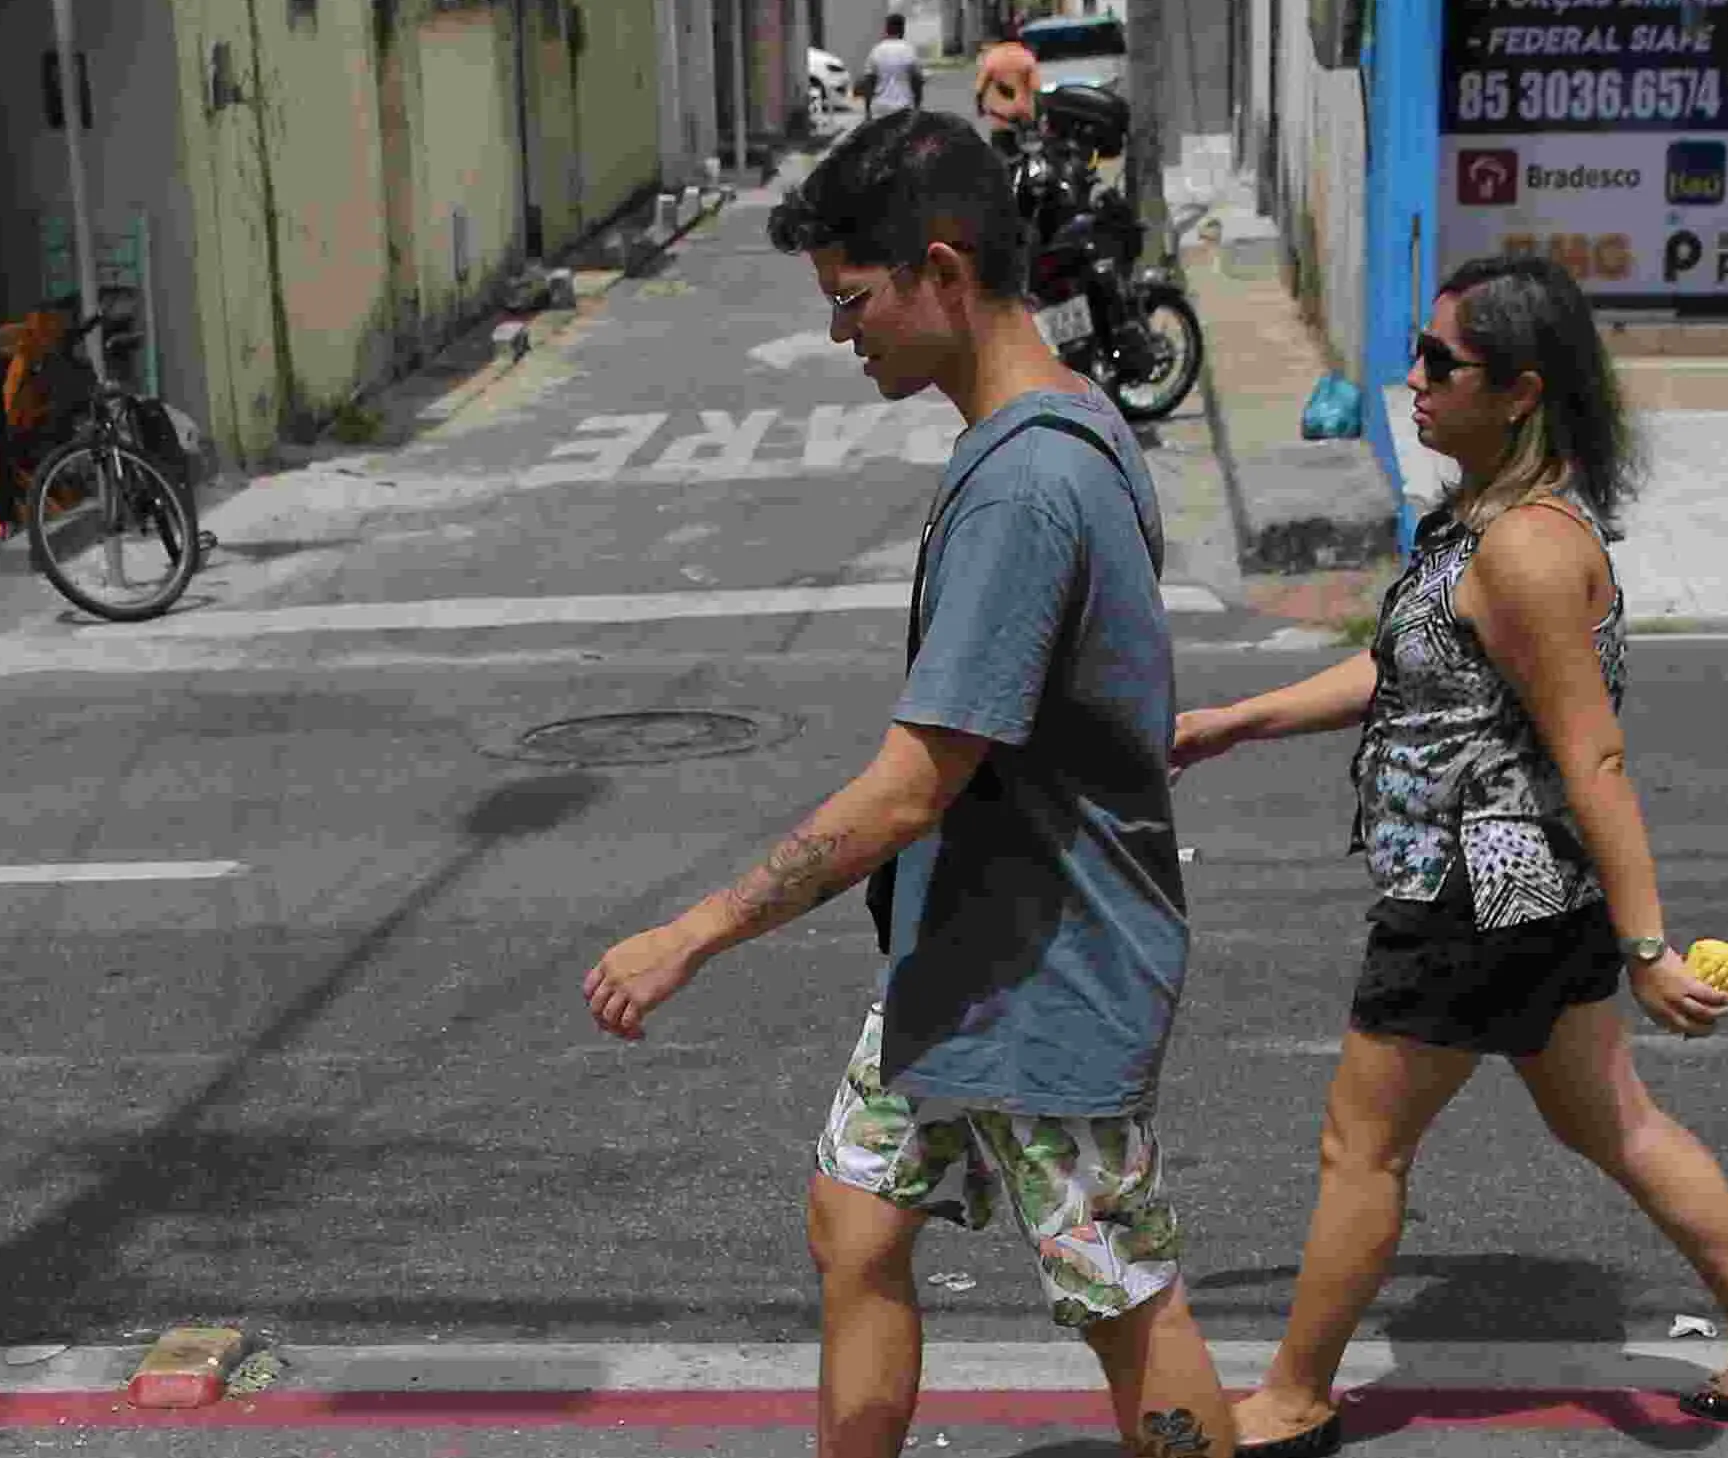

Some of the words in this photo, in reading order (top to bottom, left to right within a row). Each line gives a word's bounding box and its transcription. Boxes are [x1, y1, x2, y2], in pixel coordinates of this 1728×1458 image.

[1489, 25, 1621, 53] FEDERAL
[1458, 68, 1510, 120] 85
[1519, 66, 1721, 120] 3036.6574
[1526, 164, 1641, 190] Bradesco
